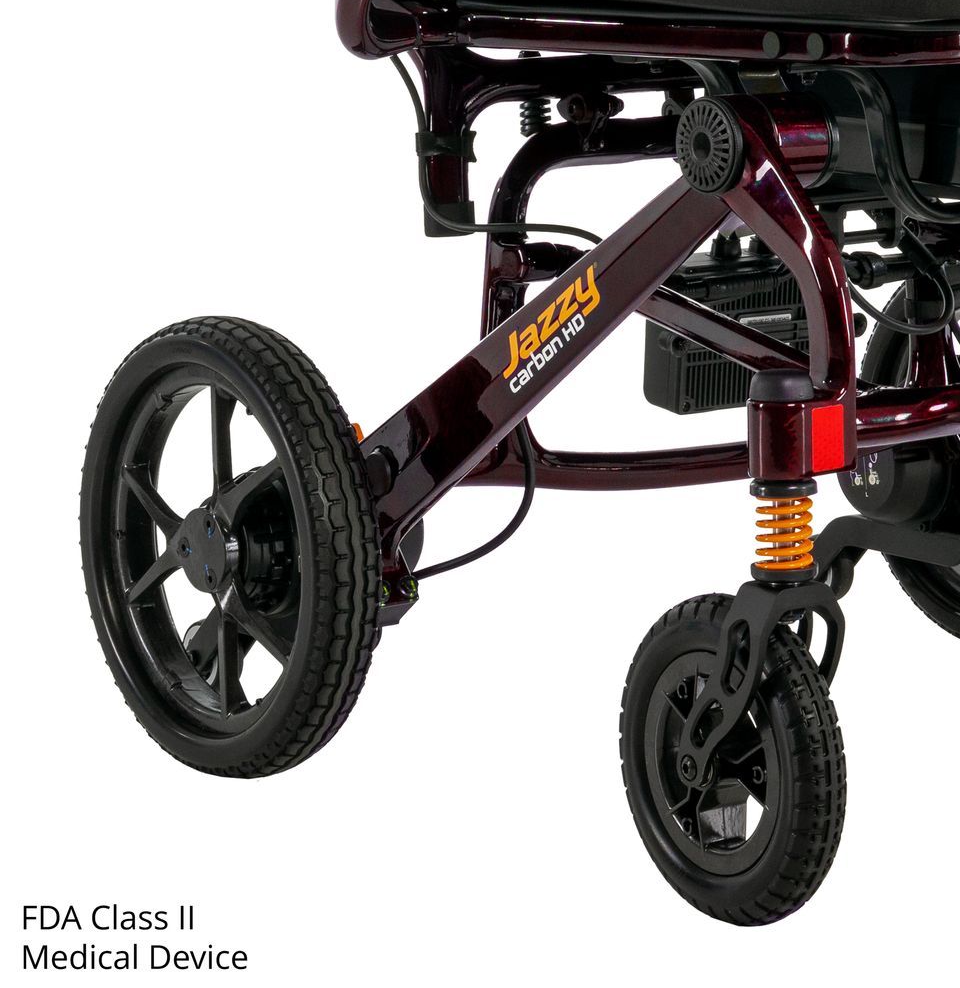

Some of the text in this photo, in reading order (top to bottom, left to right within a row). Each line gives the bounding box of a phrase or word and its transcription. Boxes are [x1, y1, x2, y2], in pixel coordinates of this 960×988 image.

[503, 265, 600, 379] Jazzy
[509, 313, 586, 394] carbon HD
